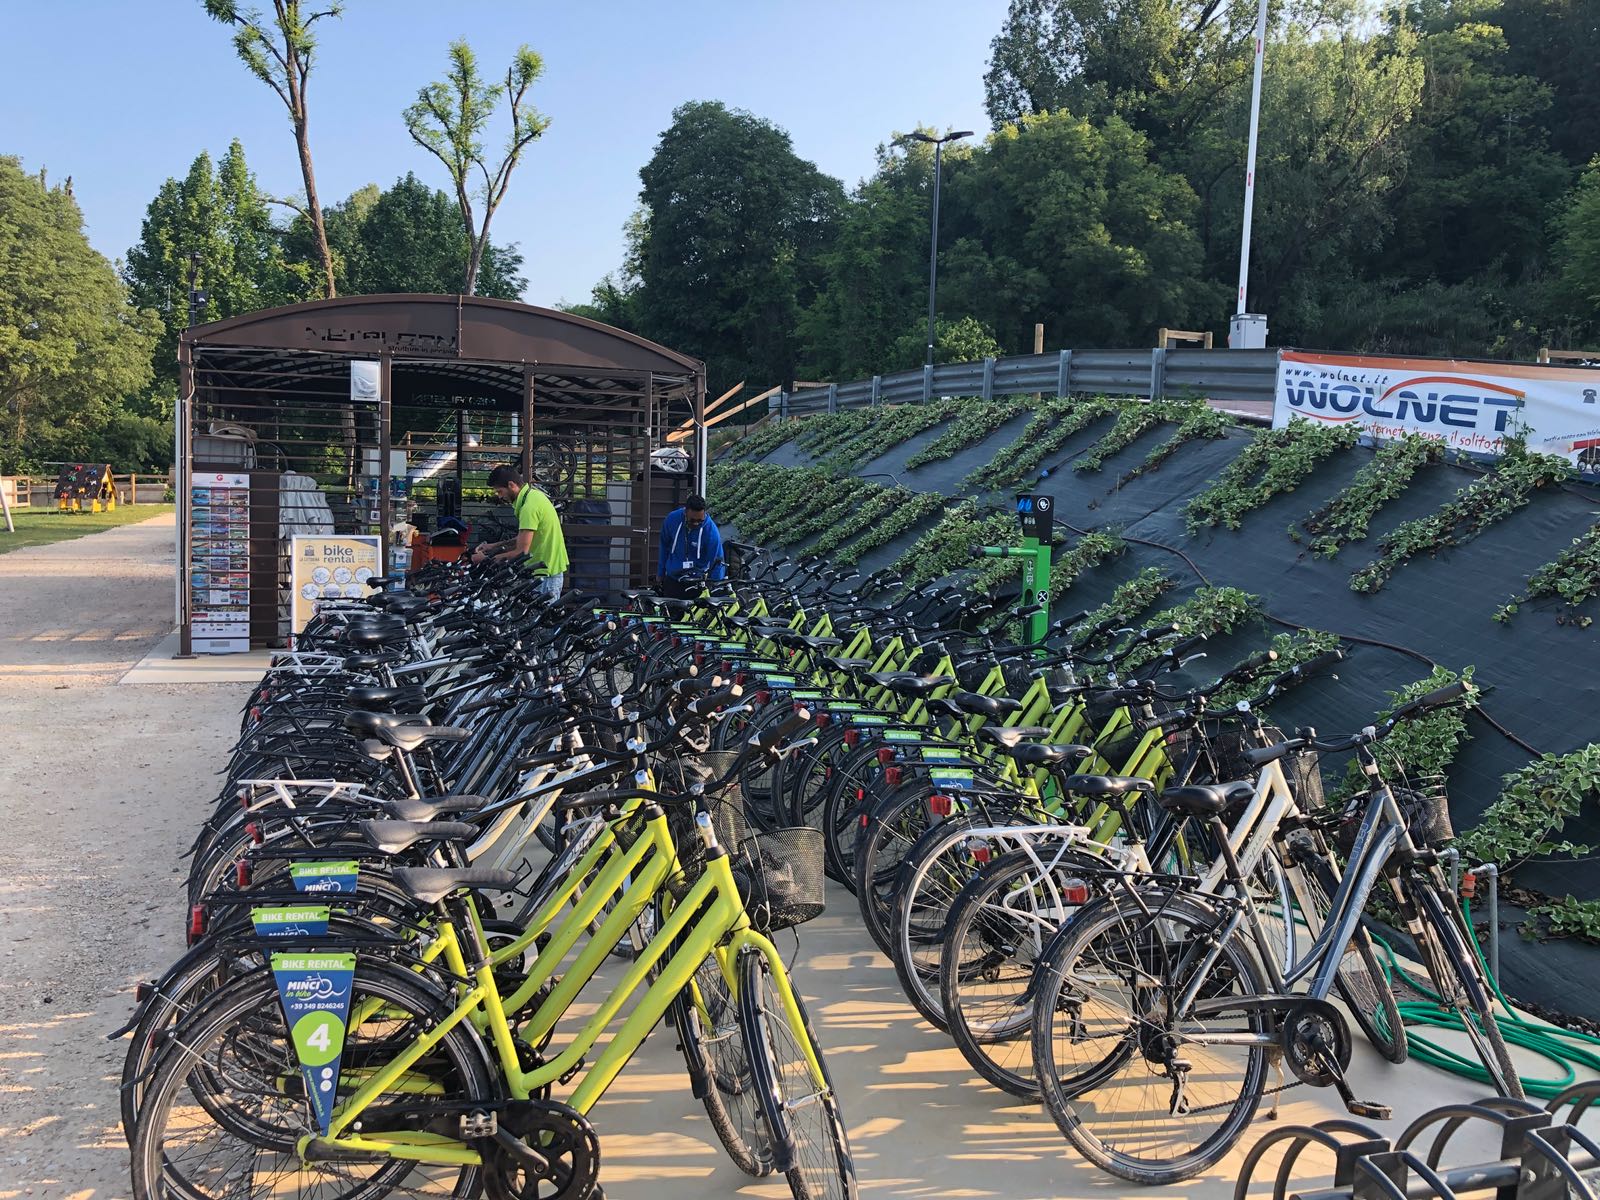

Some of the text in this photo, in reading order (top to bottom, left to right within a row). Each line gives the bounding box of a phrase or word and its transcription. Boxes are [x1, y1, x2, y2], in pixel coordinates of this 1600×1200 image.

[1286, 368, 1388, 384] www.wolnet.it
[1285, 379, 1525, 432] WOLNET
[1362, 420, 1404, 437] internet
[1450, 430, 1458, 444] il
[1460, 432, 1490, 450] solito
[324, 545, 353, 556] bike
[262, 912, 320, 921] BIKE RENTAL
[282, 959, 346, 969] BIKE RENTAL
[306, 1023, 331, 1052] 4
